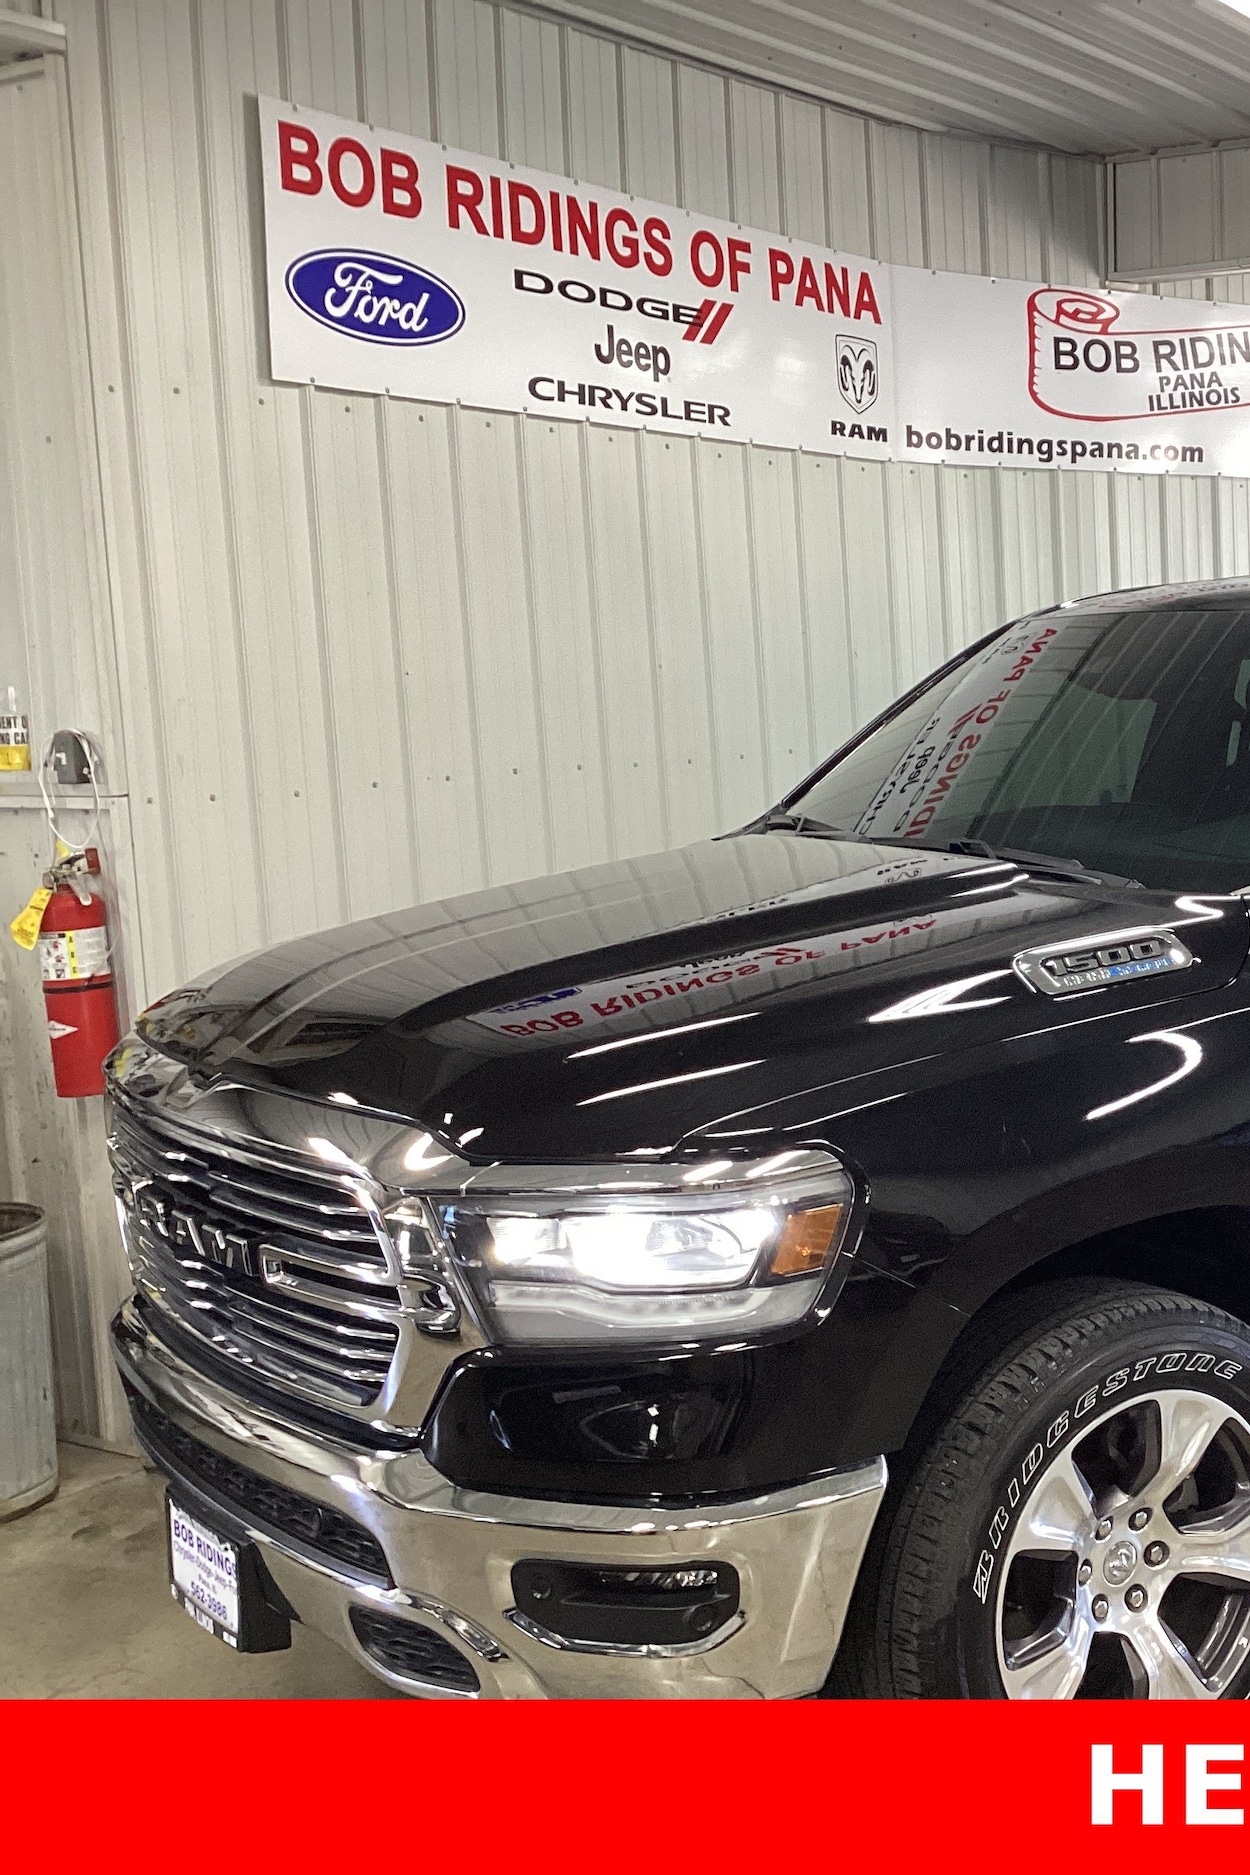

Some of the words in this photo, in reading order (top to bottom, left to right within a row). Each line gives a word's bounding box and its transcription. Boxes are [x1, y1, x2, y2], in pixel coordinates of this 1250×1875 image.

[278, 120, 423, 219] BOB
[445, 164, 673, 278] RIDINGS
[690, 230, 752, 293] OF
[769, 248, 883, 325] PANA
[324, 261, 431, 333] Ford
[513, 268, 705, 327] DODGE
[594, 324, 672, 382] Jeep
[1053, 335, 1140, 374] BOB
[528, 376, 732, 427] CHRYSLER
[1148, 387, 1241, 412] ILLINOIS
[1159, 371, 1224, 393] PANA
[830, 420, 889, 443] RAM
[905, 424, 1205, 464] bobridingspana.com
[1045, 940, 1164, 978] 1500
[972, 1351, 1244, 1605] BRIDGESTONE
[174, 1519, 195, 1549] BOB
[196, 1536, 238, 1579] RIDINGS
